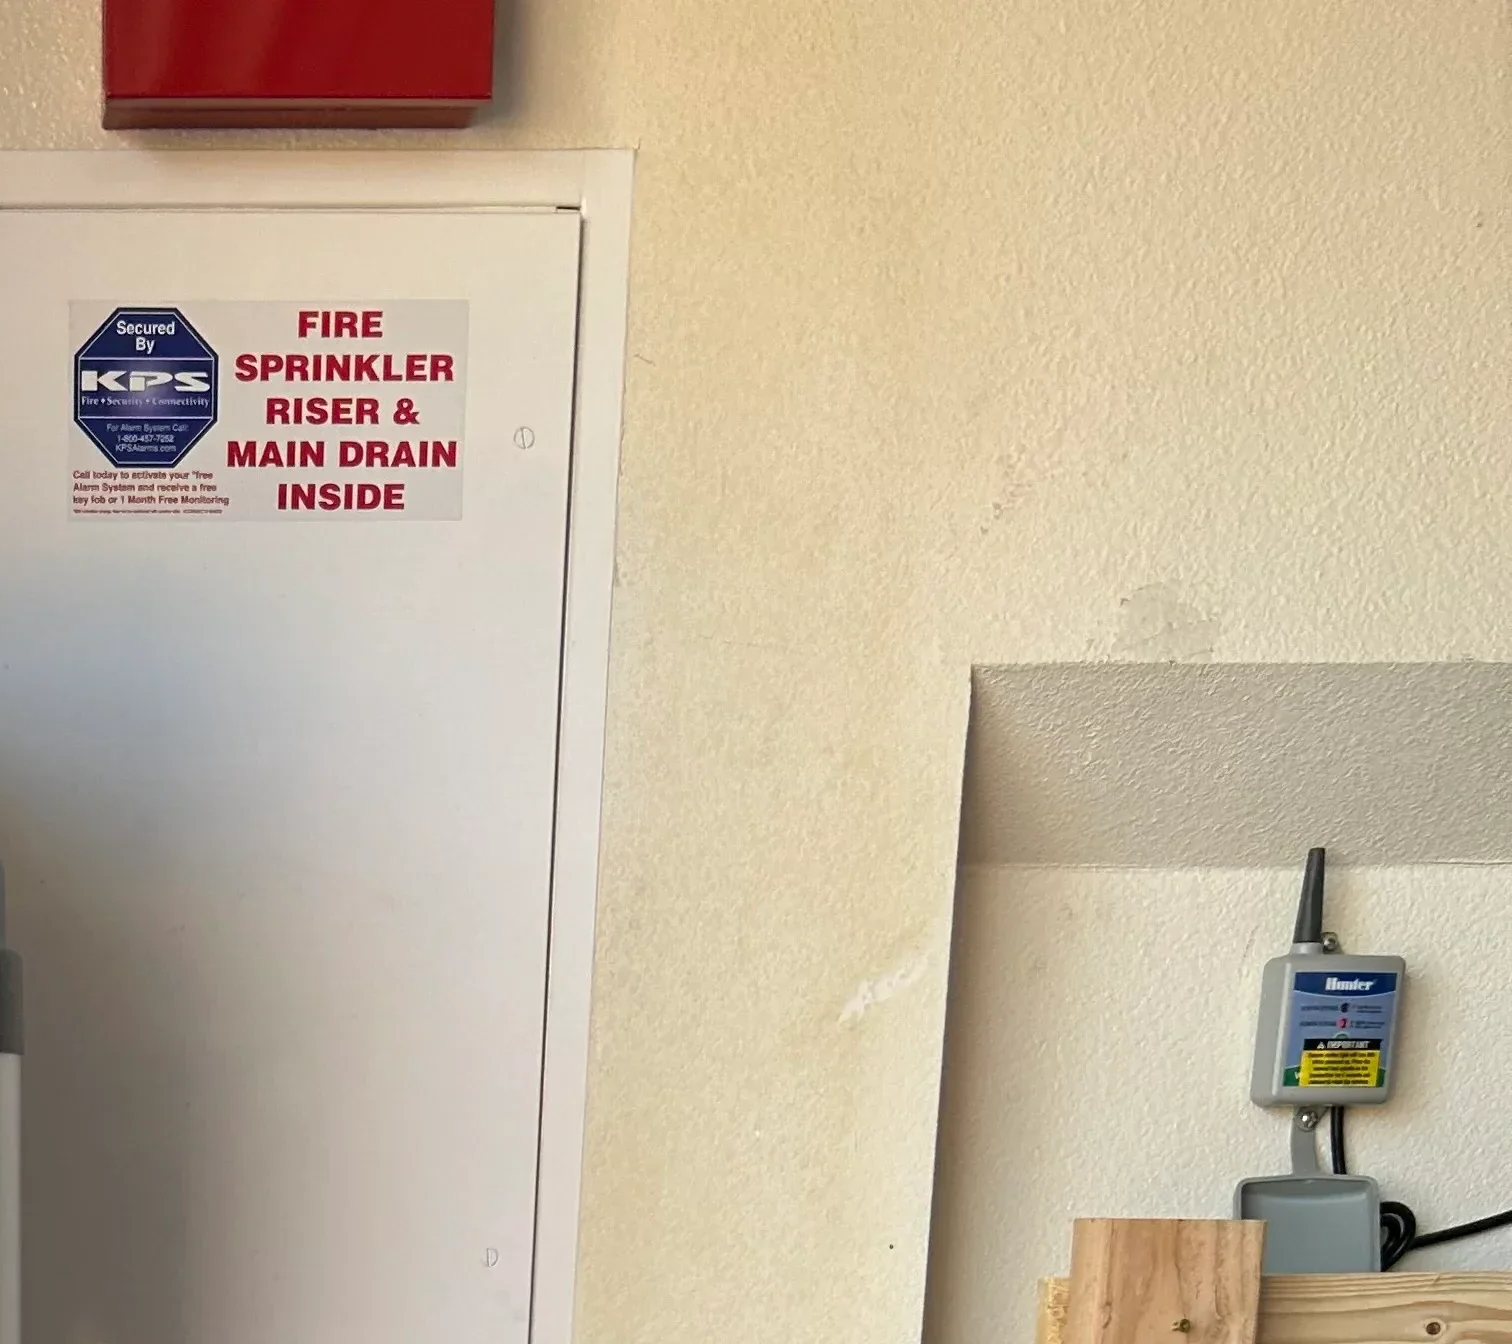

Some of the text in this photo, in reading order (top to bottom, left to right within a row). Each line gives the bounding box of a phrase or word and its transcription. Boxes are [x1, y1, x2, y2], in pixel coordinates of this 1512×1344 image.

[116, 320, 176, 336] Secured
[297, 310, 384, 338] FIRE
[135, 336, 155, 354] By
[234, 353, 455, 382] SPRINKLER
[81, 370, 211, 393] KPS
[81, 396, 209, 408] Fire Security Connectivity
[265, 397, 420, 425] RISER &
[120, 423, 143, 432] Alarm
[226, 440, 457, 468] MAIN DRAIN
[73, 470, 90, 480] Call
[92, 470, 118, 482] today
[120, 470, 130, 480] to
[131, 470, 167, 480] activate
[169, 473, 190, 482] your
[73, 483, 100, 492] Alarm
[101, 483, 136, 494] System
[137, 483, 155, 492] and
[156, 483, 189, 492] receive
[199, 483, 217, 492] free
[276, 482, 405, 511] INSIDE
[73, 495, 88, 506] key
[90, 495, 105, 504] fob
[127, 495, 156, 504] Month
[158, 495, 179, 504] Free
[180, 495, 230, 507] Monitoring
[1325, 977, 1375, 991] Hunter
